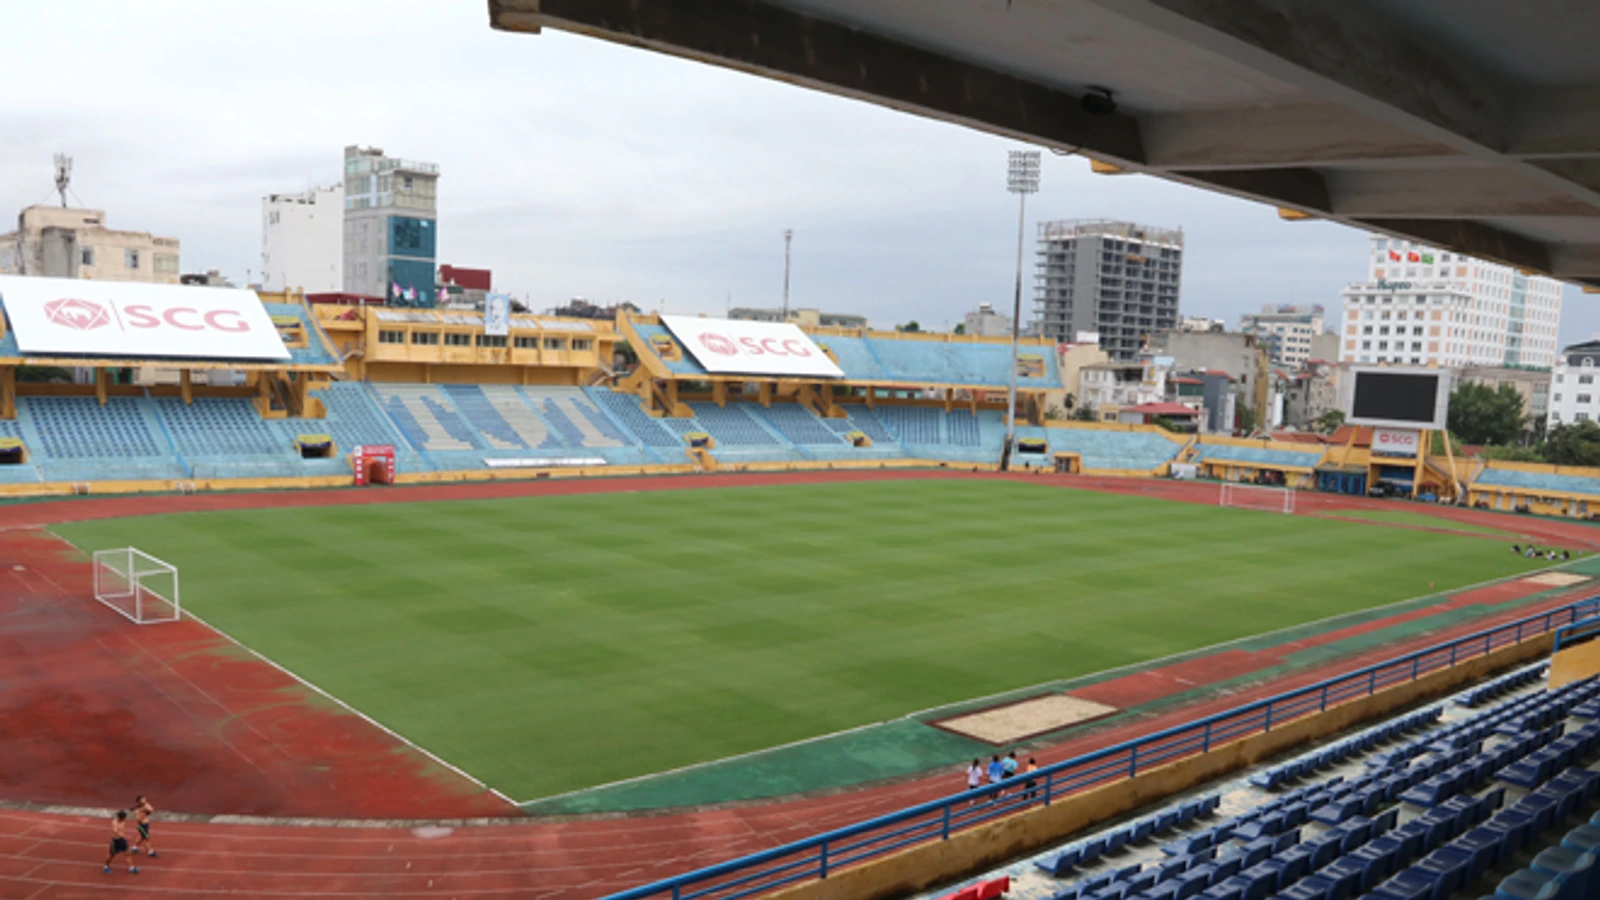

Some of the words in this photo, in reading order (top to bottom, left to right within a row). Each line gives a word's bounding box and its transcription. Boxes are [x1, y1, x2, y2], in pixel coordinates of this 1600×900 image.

[123, 304, 251, 333] SCG
[739, 336, 813, 358] SCG
[1391, 434, 1413, 445] SCG
